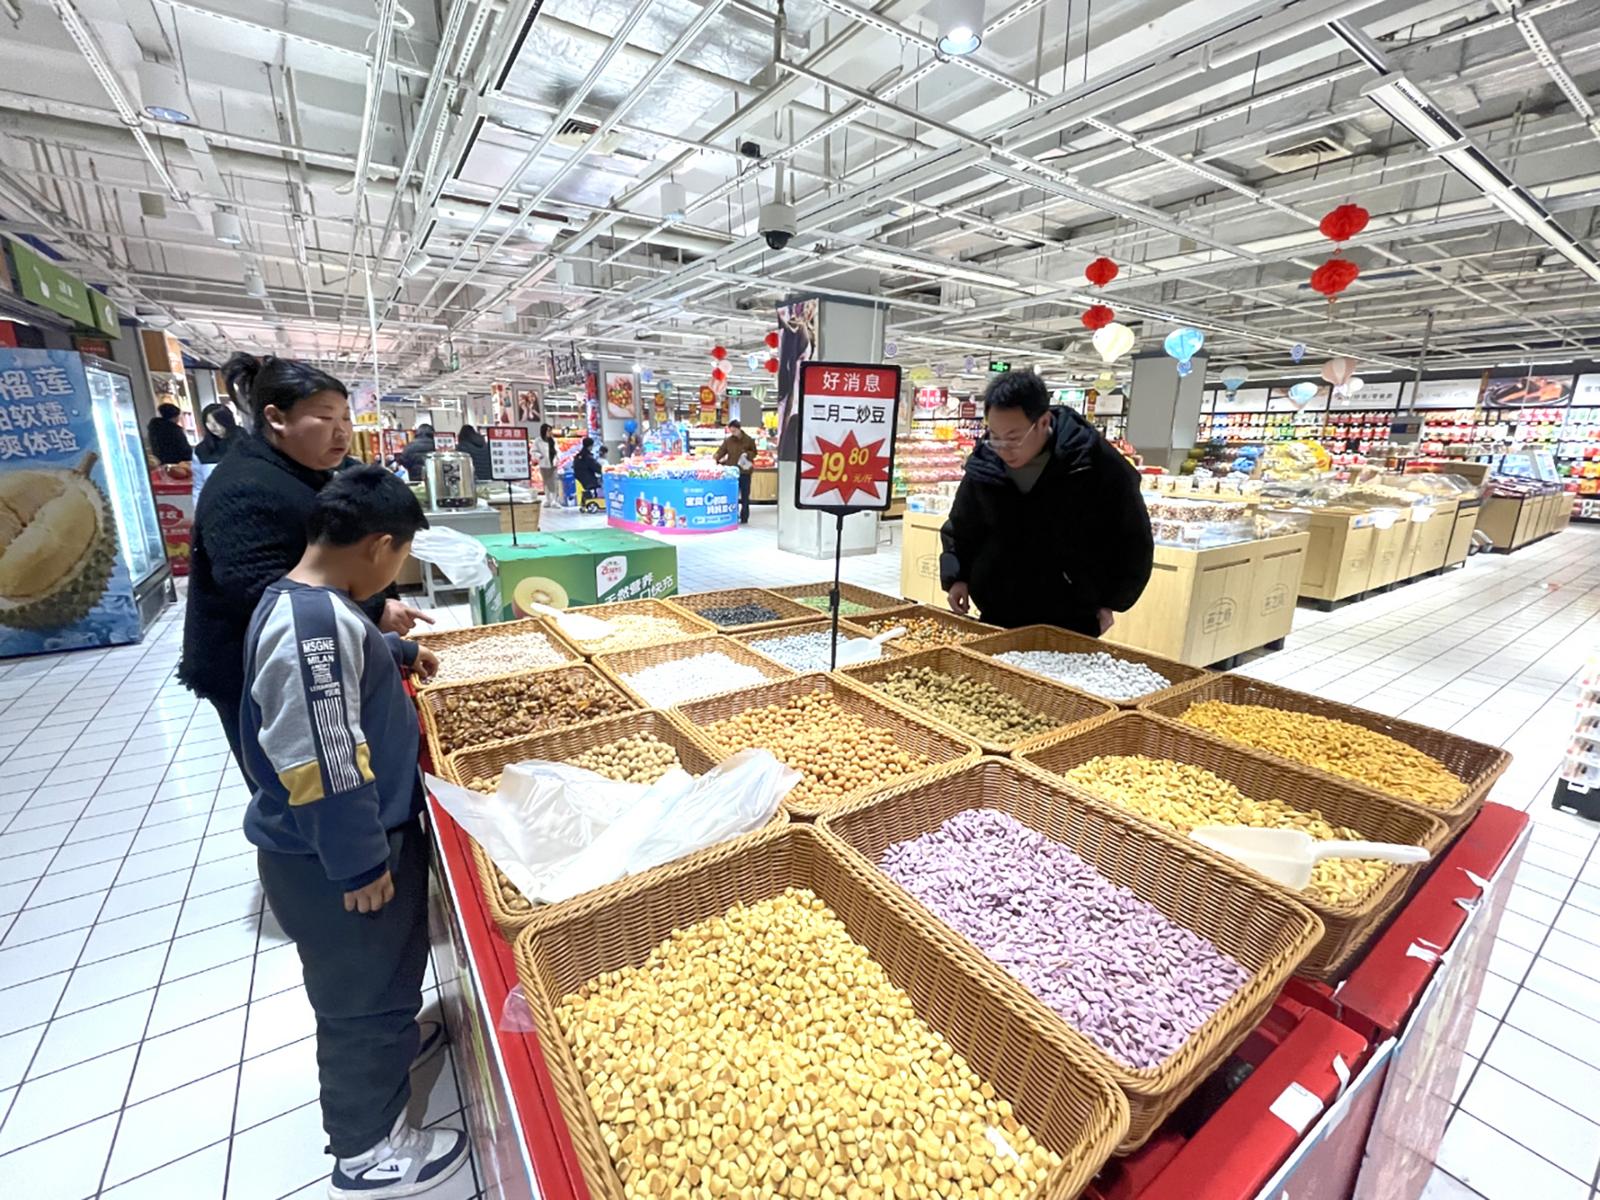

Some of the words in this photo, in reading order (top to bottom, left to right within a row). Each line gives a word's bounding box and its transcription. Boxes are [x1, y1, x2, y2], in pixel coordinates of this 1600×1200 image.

[822, 371, 880, 392] 好消息
[302, 640, 335, 653] MSGNE
[308, 655, 334, 665] MILAN
